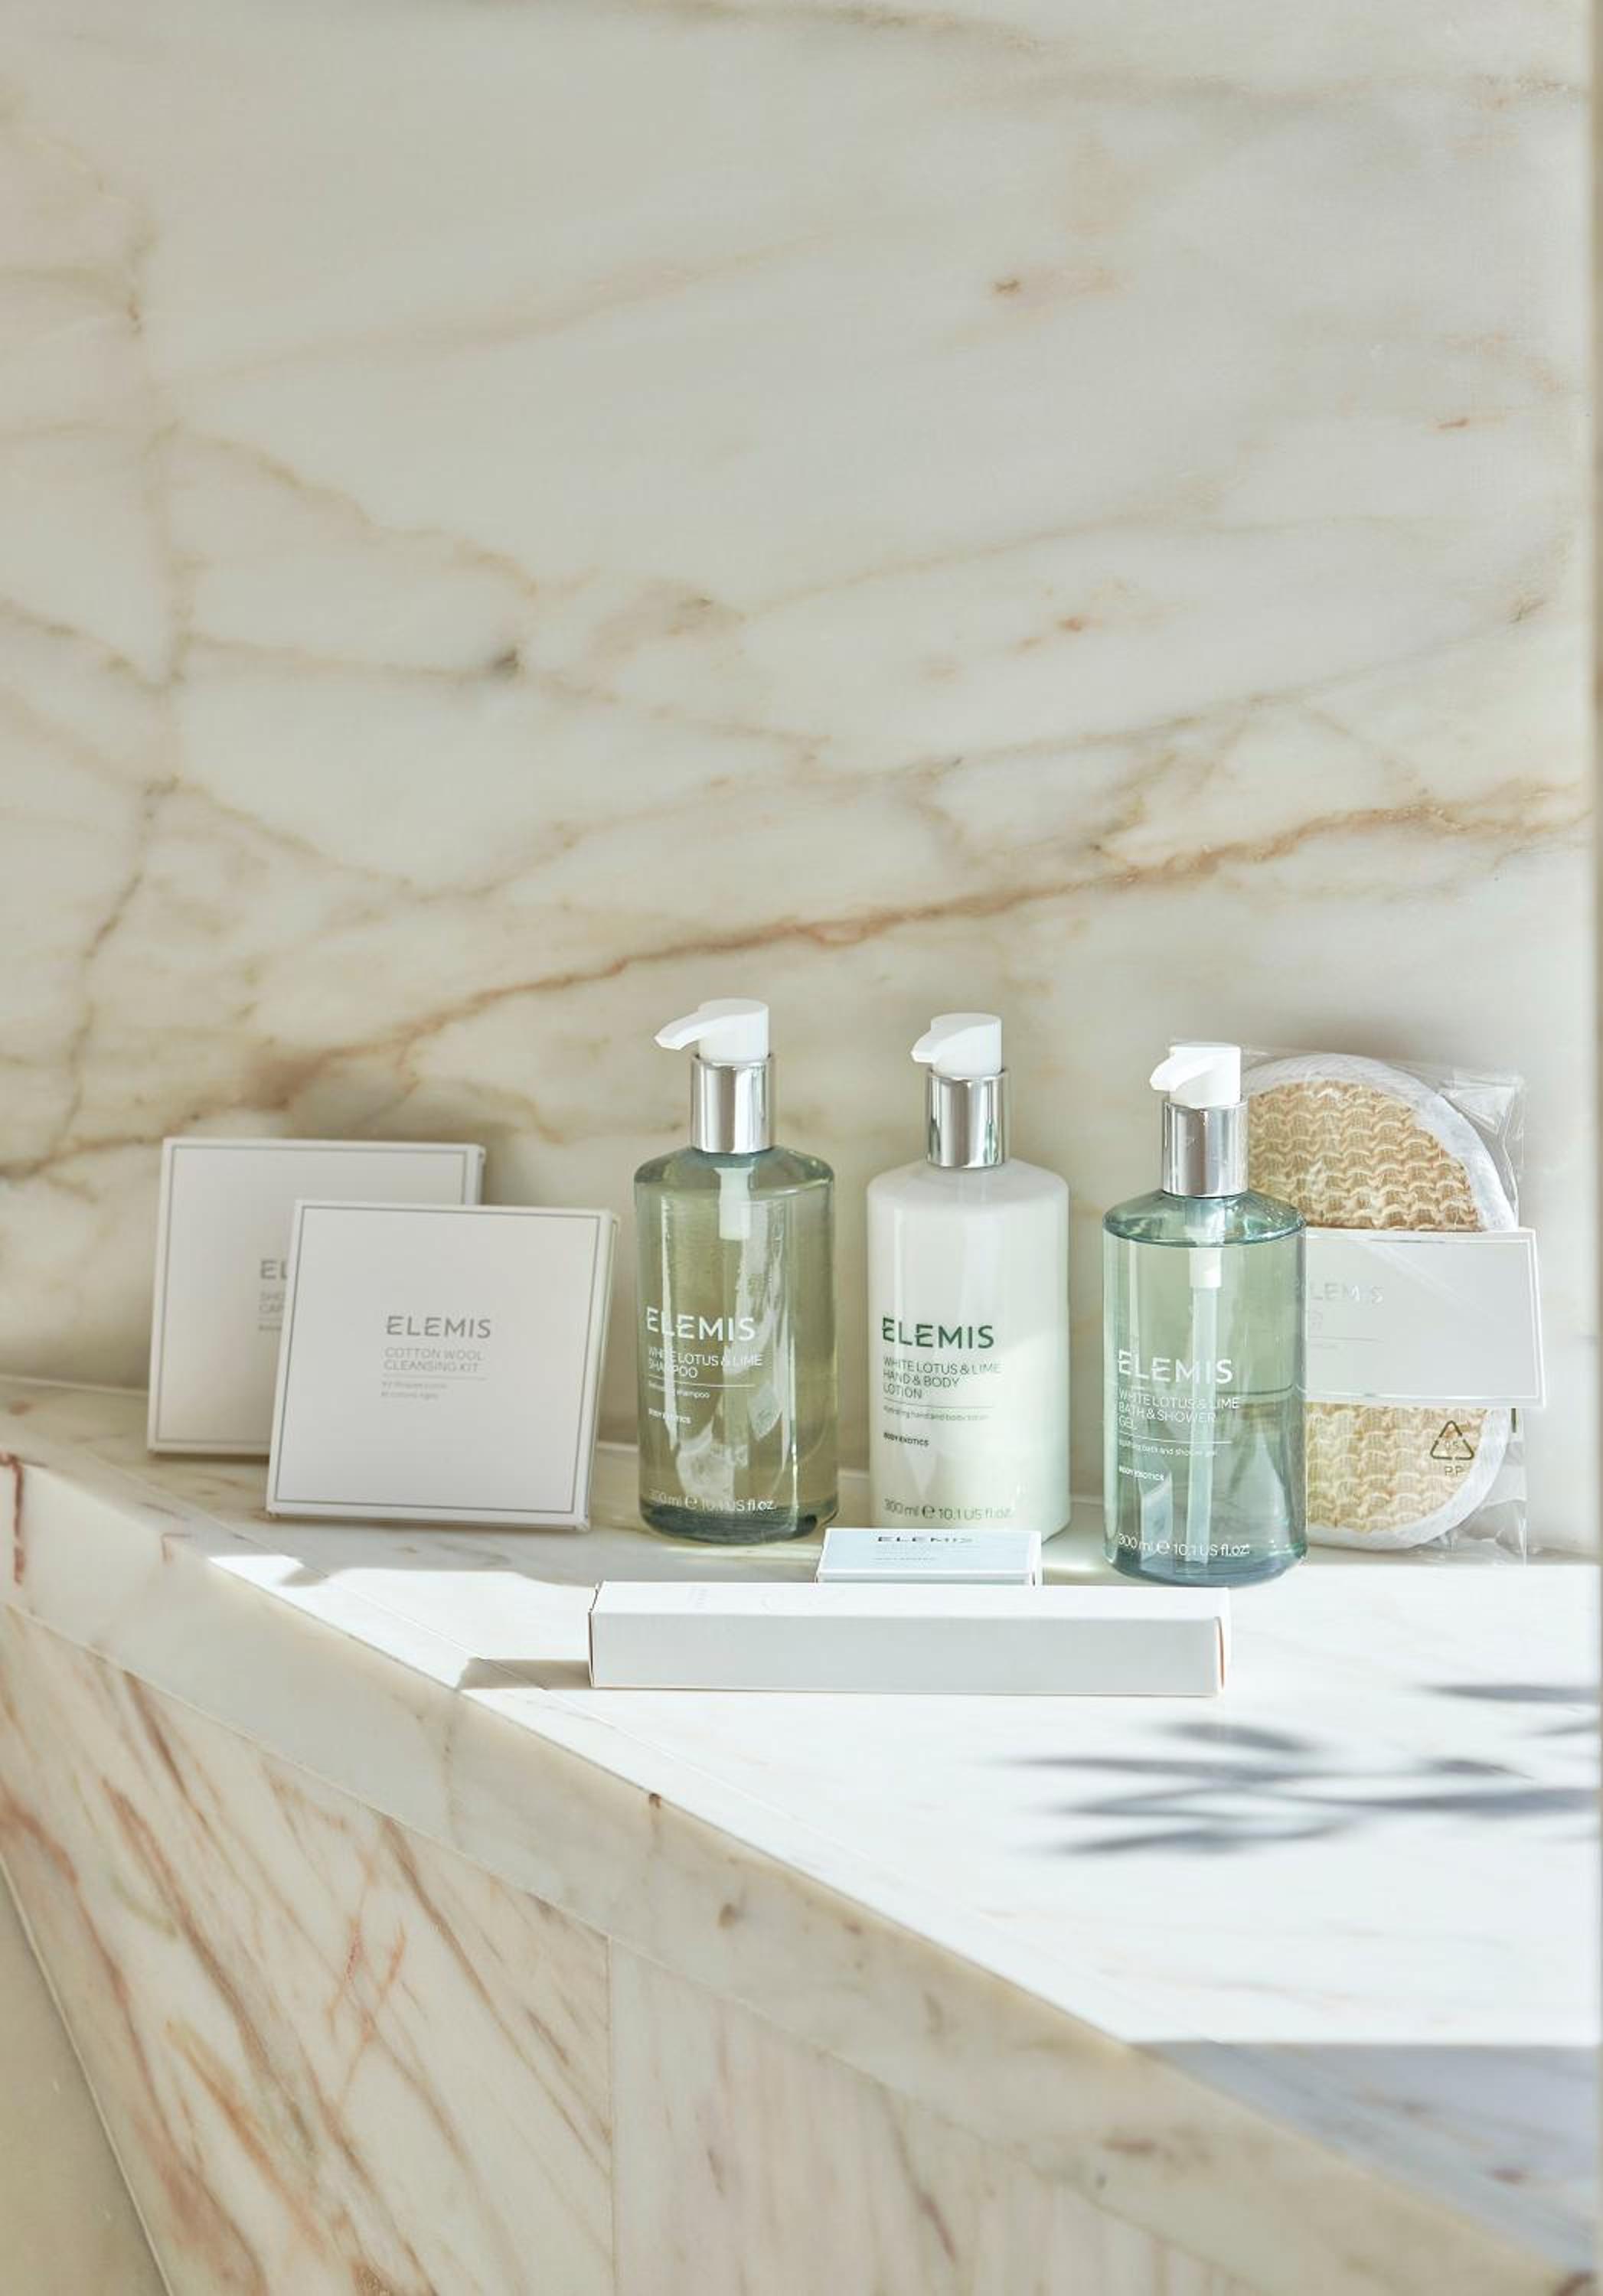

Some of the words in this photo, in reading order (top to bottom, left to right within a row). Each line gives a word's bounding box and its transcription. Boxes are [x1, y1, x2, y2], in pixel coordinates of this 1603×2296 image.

[387, 1315, 491, 1339] ELEMIS
[647, 1306, 756, 1342] ELEMIS
[882, 1316, 994, 1349] ELEMIS
[384, 1347, 441, 1360] COTTON
[443, 1349, 486, 1362] WOOL
[678, 1352, 719, 1367] LOTUS
[384, 1358, 458, 1372] CLEANSING
[459, 1362, 479, 1372] KIT
[883, 1355, 916, 1372] WHITE
[916, 1362, 958, 1376] LOTUS
[959, 1365, 970, 1376] &
[971, 1362, 1002, 1375] LIME
[1118, 1349, 1233, 1384] ELEMIS
[883, 1369, 911, 1385] HAND
[912, 1375, 921, 1387] &
[924, 1376, 961, 1389] BODY
[883, 1383, 922, 1399] LOTION
[1118, 1388, 1151, 1407] WHITE
[1152, 1396, 1195, 1410] LOTUS
[1118, 1401, 1145, 1420] BATH
[1146, 1407, 1157, 1420] &
[1157, 1408, 1217, 1424] SHOWER
[1119, 1415, 1138, 1430] GEL
[1445, 1466, 1464, 1477] PP
[939, 1507, 961, 1521] 10.1
